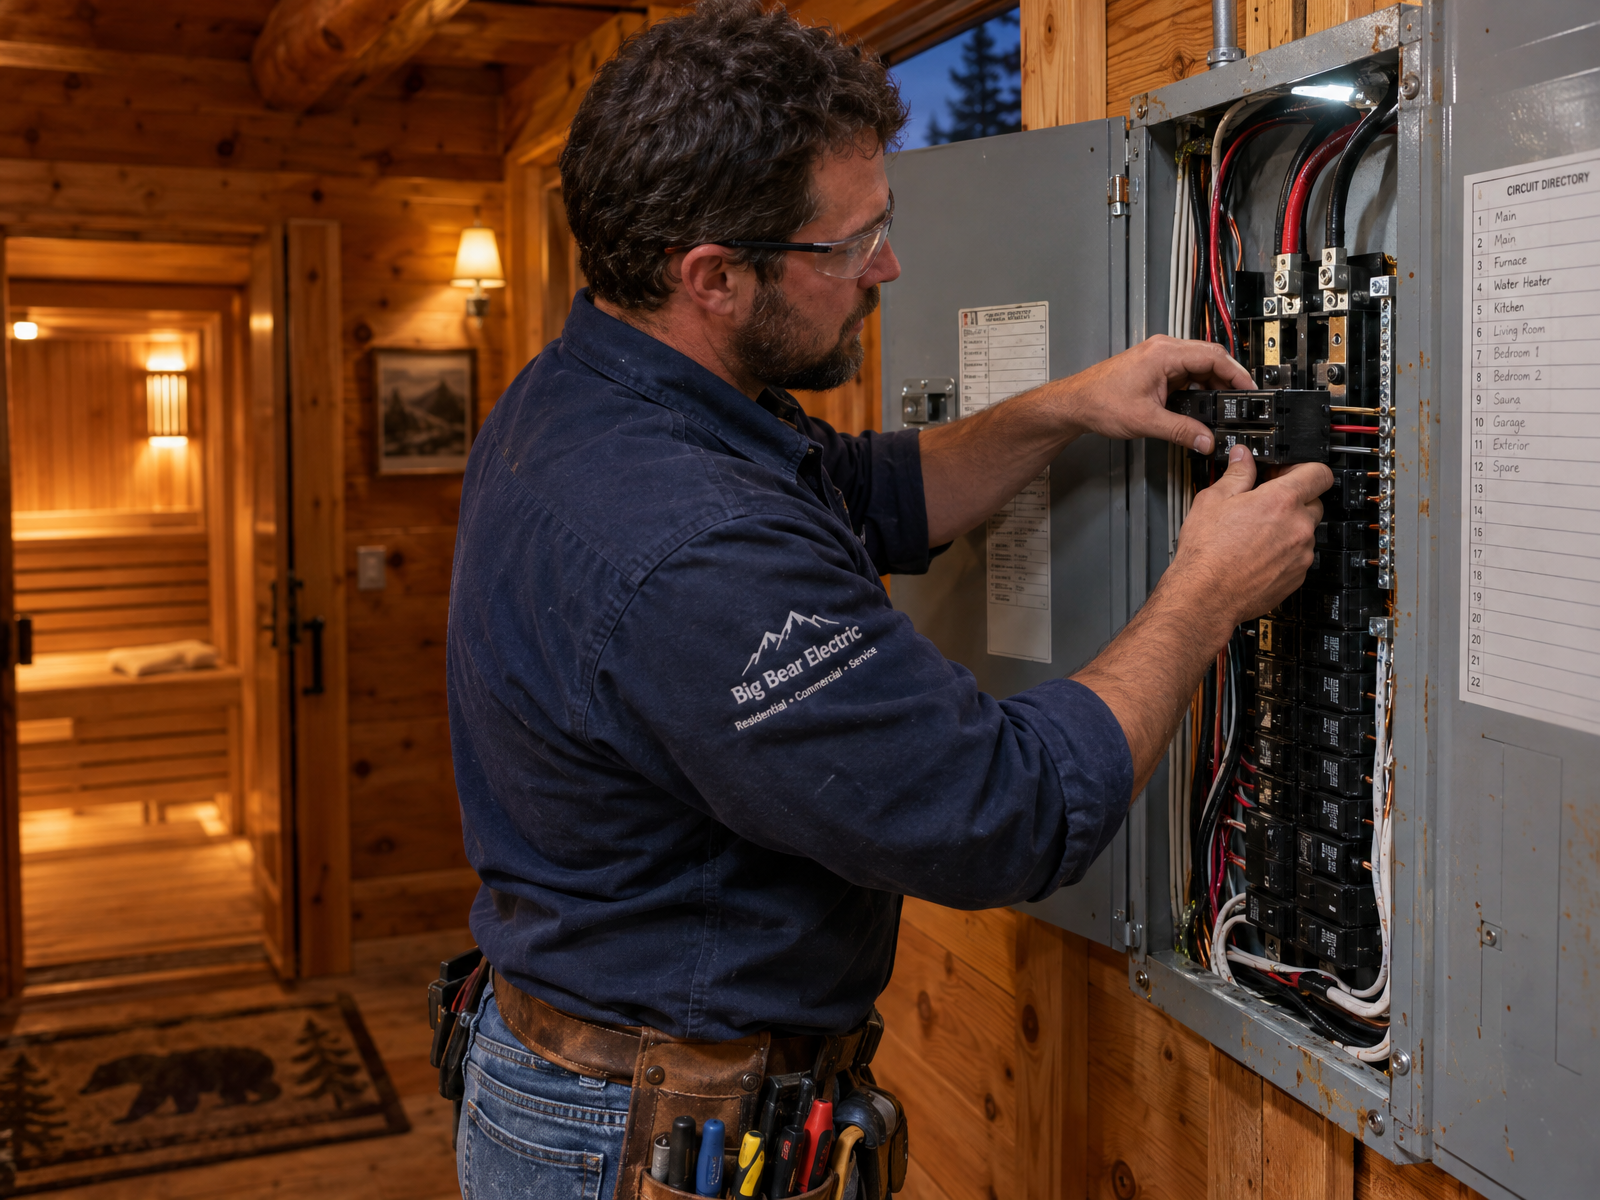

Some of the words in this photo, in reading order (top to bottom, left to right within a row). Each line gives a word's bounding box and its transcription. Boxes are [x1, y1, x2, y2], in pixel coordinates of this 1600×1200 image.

[1507, 181, 1539, 196] CIRCUIT
[1541, 171, 1590, 190] DIRECTORY
[1478, 216, 1482, 226] 1
[1494, 210, 1517, 224] Main
[1477, 238, 1483, 248] 2
[1494, 233, 1516, 247] Main
[1477, 260, 1483, 271] 3
[1494, 256, 1527, 269] Furnace
[1476, 283, 1482, 292] 4
[1494, 278, 1519, 291] Water
[1523, 275, 1552, 288] Heater
[1477, 305, 1482, 315] 5
[1494, 300, 1524, 314] Kitchen
[1476, 327, 1482, 338] 6
[1493, 325, 1518, 341] Living
[1522, 322, 1545, 335] Room
[1476, 349, 1482, 360] 7
[1493, 346, 1530, 360] Bedroom
[1535, 346, 1540, 358] 1
[1476, 372, 1482, 382] 8
[1493, 369, 1530, 382] Bedroom
[1535, 369, 1542, 381] 2
[1476, 394, 1482, 405] 9
[1493, 392, 1521, 405] Sauna
[1475, 417, 1484, 428] 10
[1493, 415, 1526, 434] Garage
[1475, 440, 1483, 450] 11
[1492, 438, 1530, 451] Exterior
[1474, 461, 1484, 472] 12
[1492, 460, 1520, 478] Spare
[1474, 484, 1483, 494] 13
[1474, 506, 1483, 515] 14
[1473, 549, 1483, 559] 17
[1473, 570, 1482, 581] 18
[1473, 592, 1482, 602] 19
[1472, 613, 1482, 623] 20
[1471, 634, 1481, 645] 20
[730, 682, 766, 704] Big
[762, 657, 804, 689] Bear
[803, 625, 863, 667] Electric
[1471, 655, 1480, 666] 21
[1471, 676, 1481, 688] 22
[734, 699, 788, 732] Residential
[794, 666, 844, 701] Commercial
[848, 646, 878, 669] Service
